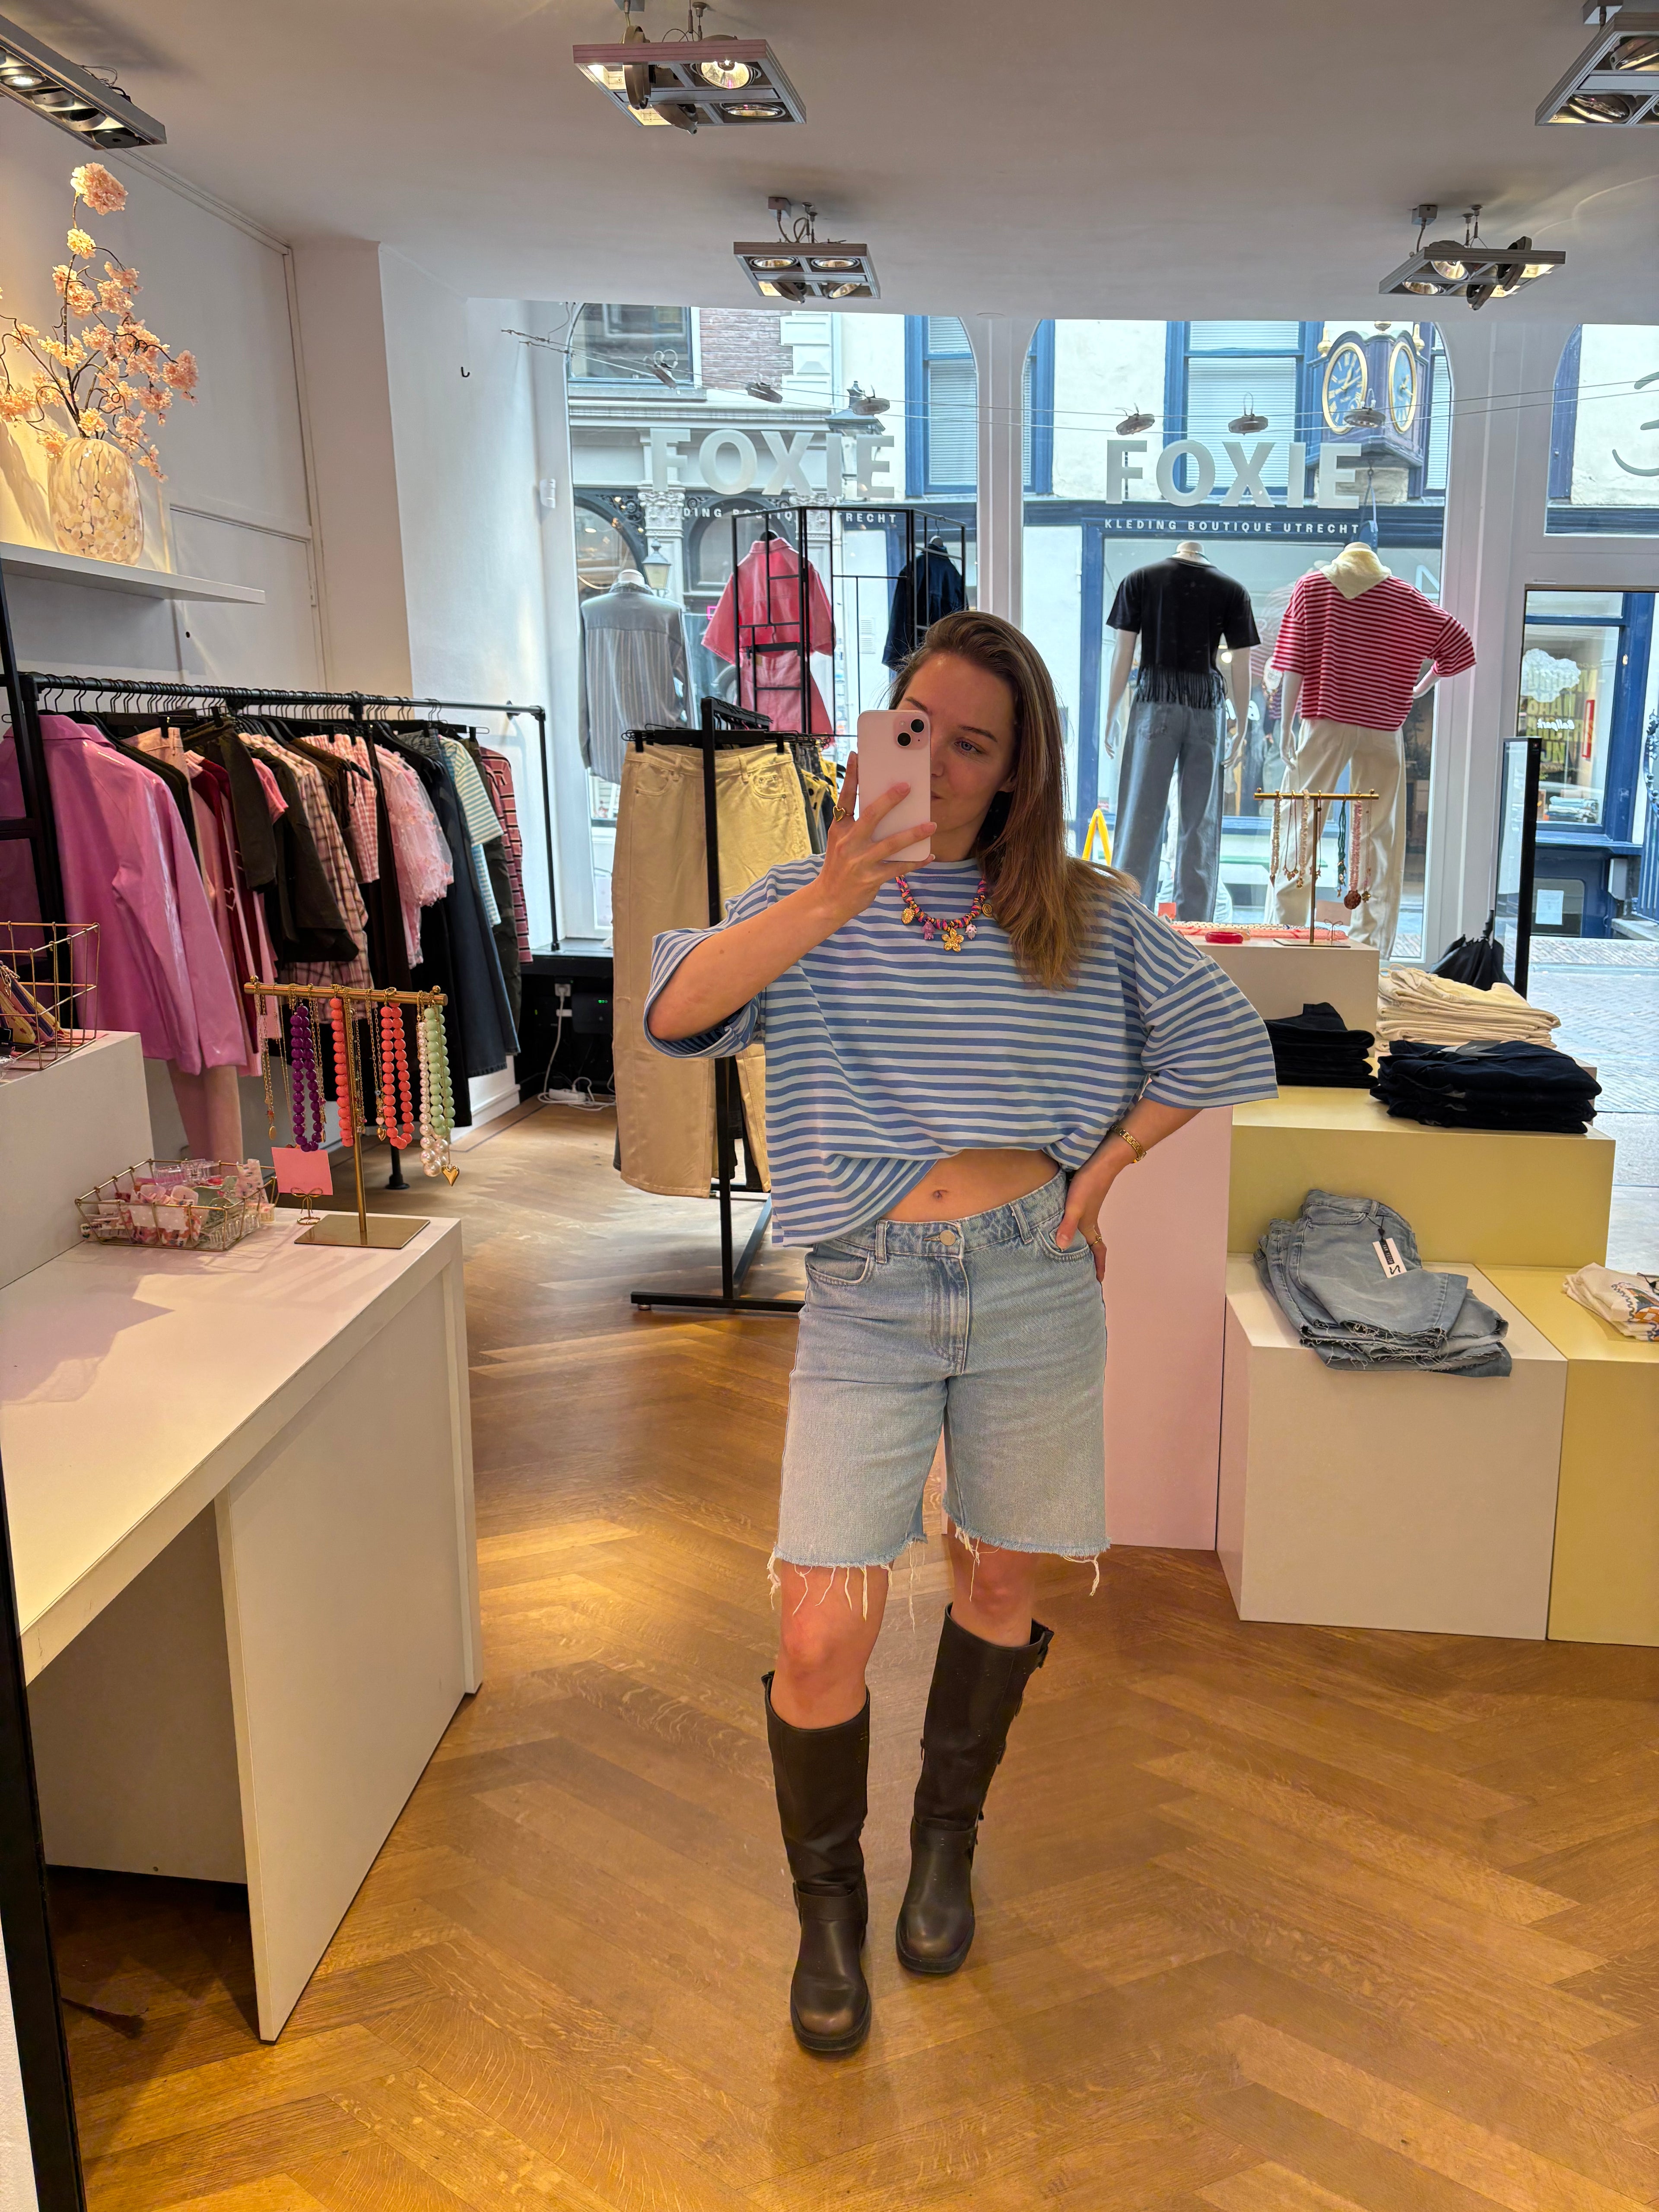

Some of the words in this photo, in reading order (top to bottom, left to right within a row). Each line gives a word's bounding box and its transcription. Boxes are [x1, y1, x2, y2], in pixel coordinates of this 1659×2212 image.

[650, 428, 895, 499] FOXIE
[1106, 440, 1362, 509] FOXIE
[1104, 519, 1177, 530] KLEDING
[1188, 521, 1272, 533] BOUTIQUE
[1283, 523, 1359, 534] UTRECHT
